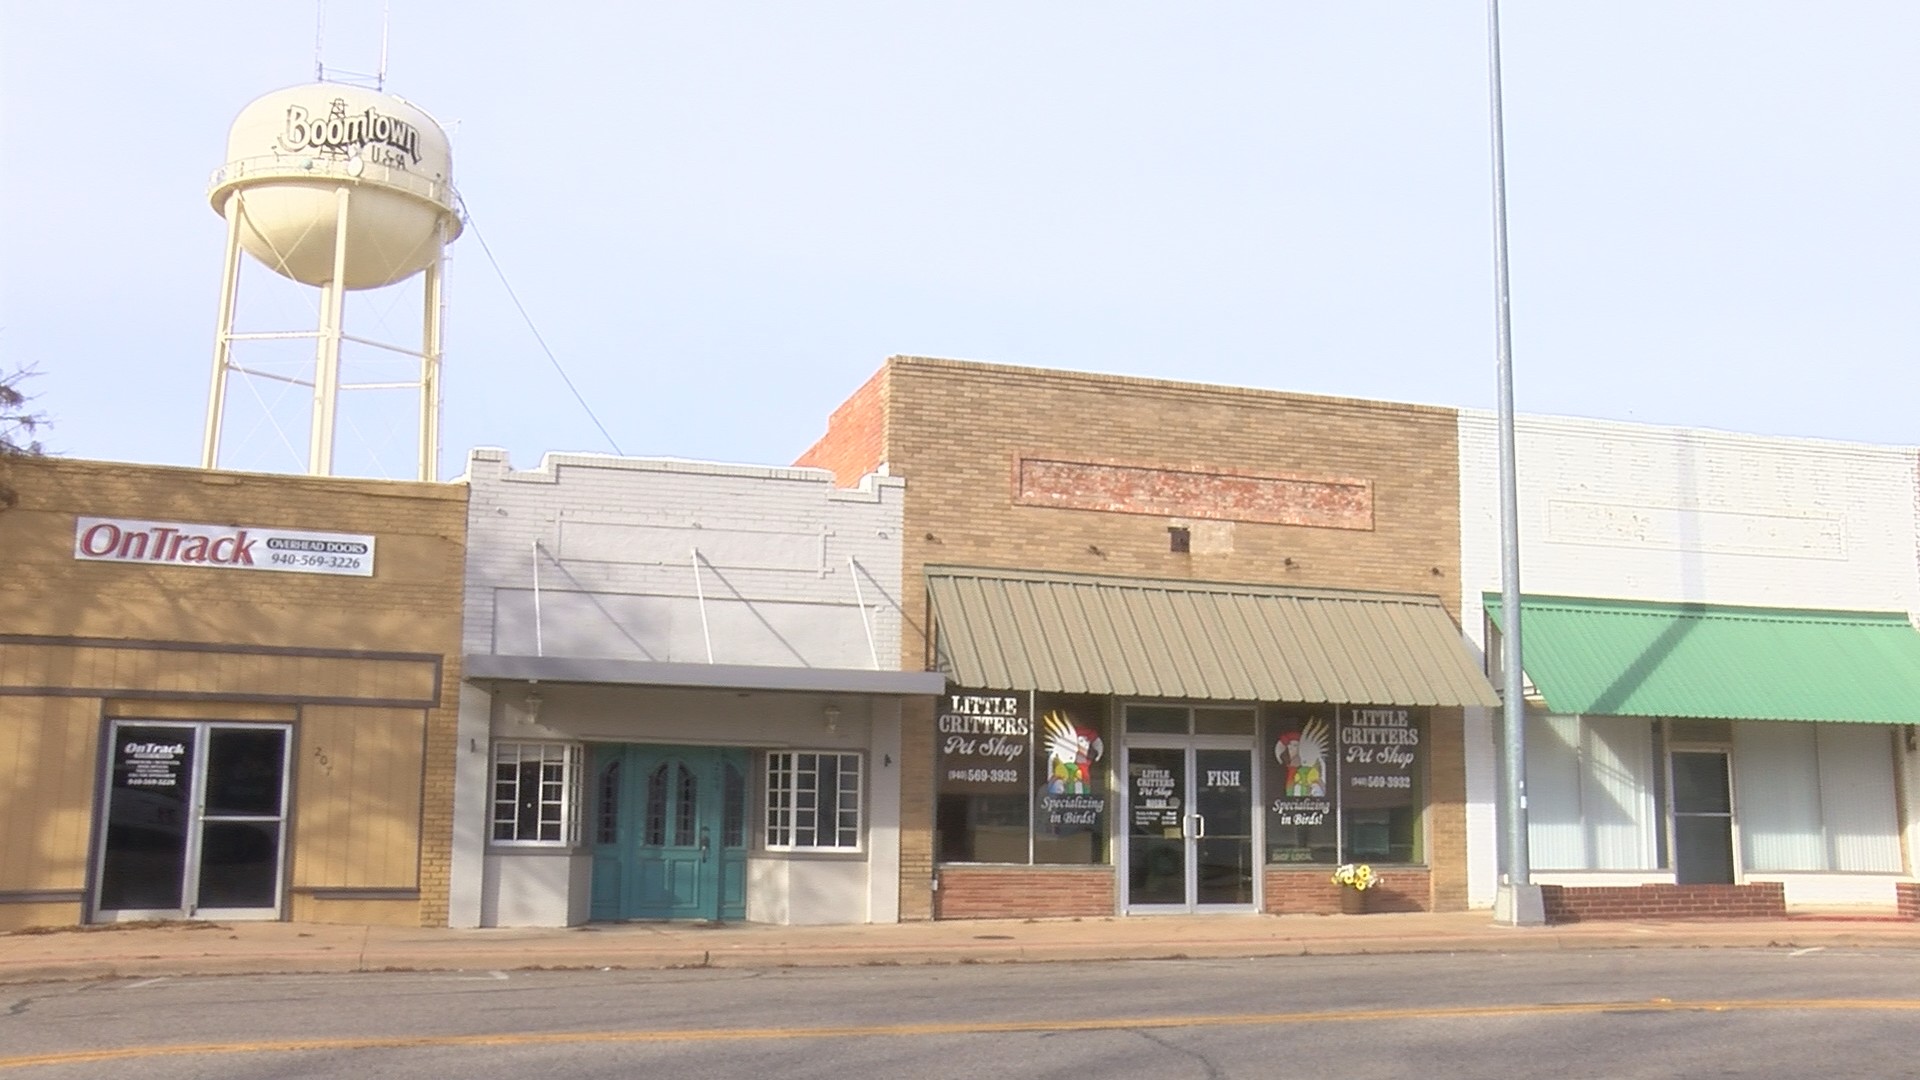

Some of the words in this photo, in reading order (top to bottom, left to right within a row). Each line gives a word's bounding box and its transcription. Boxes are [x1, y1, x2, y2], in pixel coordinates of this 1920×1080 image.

[278, 105, 422, 164] Boomtown
[80, 523, 258, 566] OnTrack
[271, 540, 325, 552] OVERHEAD
[326, 542, 367, 554] DOORS
[271, 553, 360, 569] 940-569-3226
[951, 695, 1017, 715] LITTLE
[939, 715, 1028, 735] CRITTERS
[1352, 709, 1408, 727] LITTLE
[1342, 727, 1419, 746] CRITTERS
[124, 742, 185, 754] OnTrack
[944, 736, 976, 755] Pet
[979, 736, 1023, 762] Shop
[1345, 746, 1374, 764] Pet
[1376, 745, 1415, 769] Shop
[1142, 769, 1170, 778] LITTLE
[1206, 770, 1240, 787] FISH
[1136, 778, 1175, 787] CRITTERS
[1041, 796, 1104, 811] Specializing
[1272, 798, 1331, 815] Specializing
[1050, 812, 1061, 824] in
[1063, 811, 1096, 824] Birds!
[1281, 814, 1291, 826] in
[1292, 813, 1323, 826] Birds!
